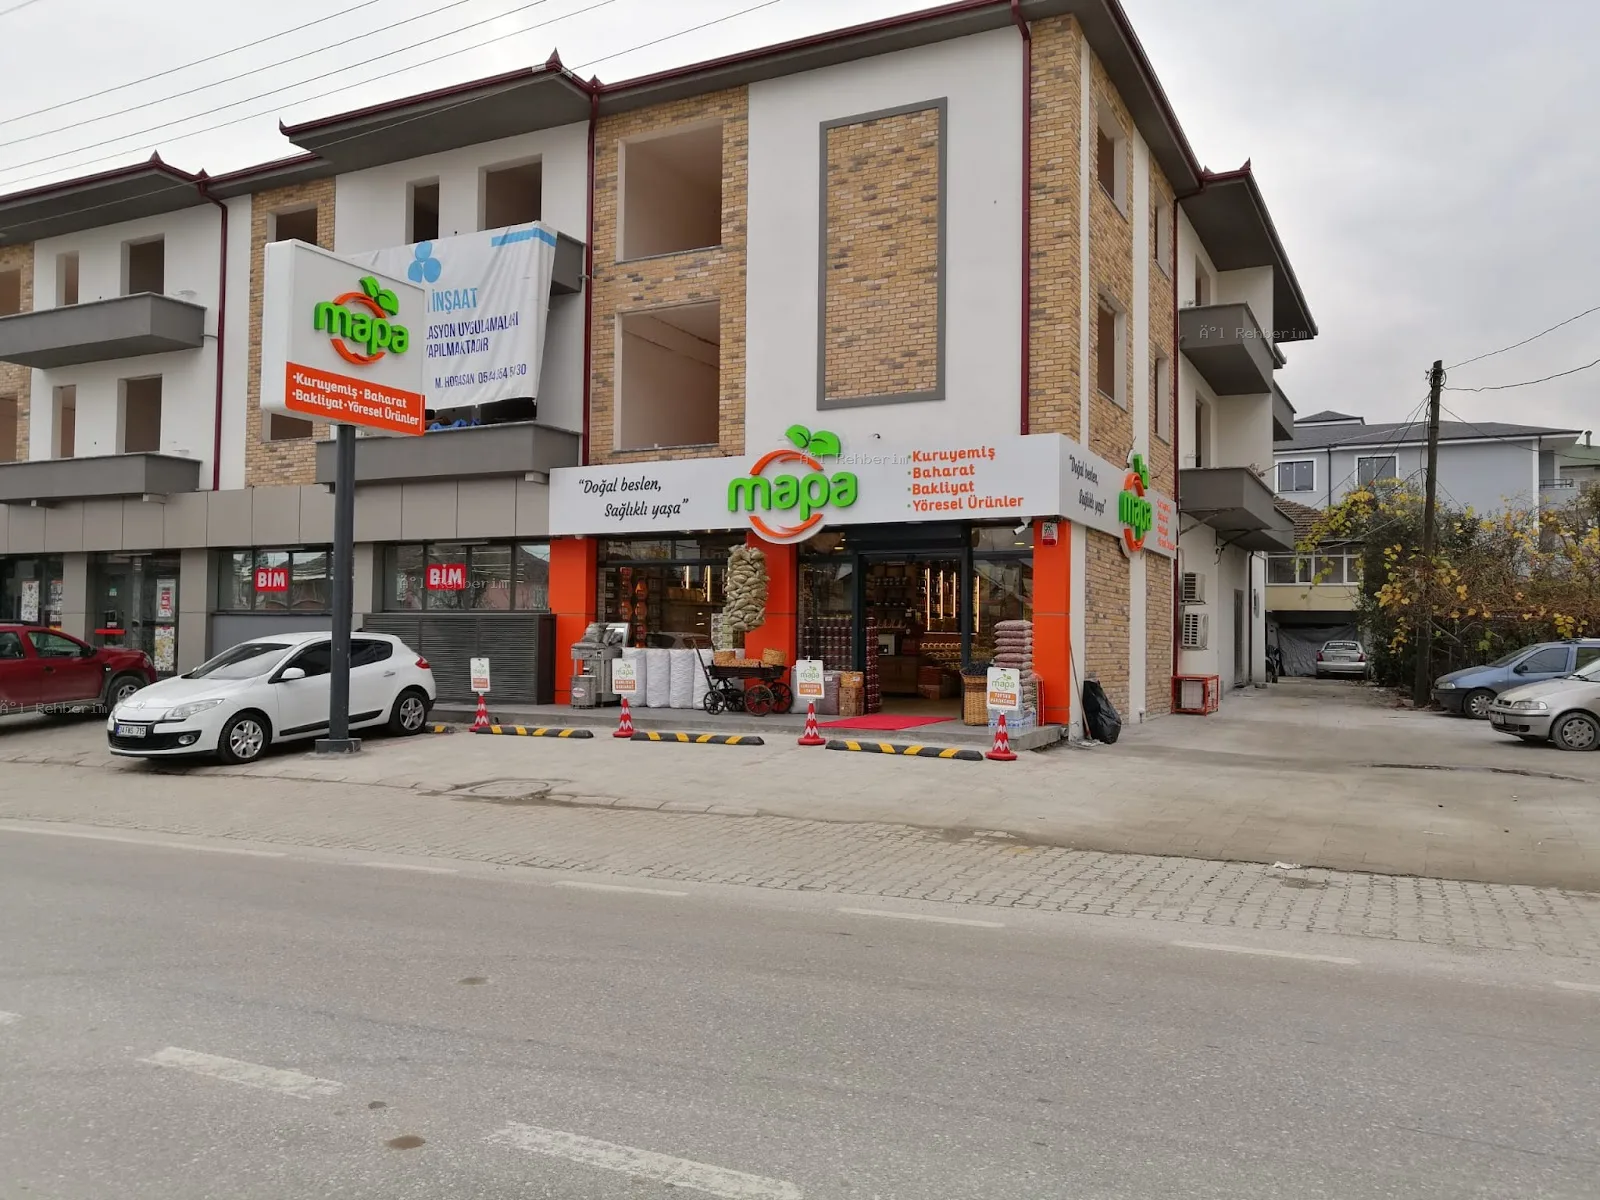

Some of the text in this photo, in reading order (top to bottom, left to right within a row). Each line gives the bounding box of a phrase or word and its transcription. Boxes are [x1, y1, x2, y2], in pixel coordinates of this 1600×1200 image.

[431, 287, 478, 314] İNŞAAT
[314, 301, 409, 356] mapa
[426, 322, 456, 340] ASYON
[444, 373, 475, 388] HORASAN
[296, 372, 407, 409] Kuruyemiş Baharat
[296, 389, 420, 426] Bakliyat Yöresel Ürünler
[912, 445, 996, 466] Kuruyemiş
[912, 464, 975, 479] Baharat
[620, 474, 662, 493] beslen,
[912, 480, 975, 496] Bakliyat
[727, 471, 859, 521] mapa
[912, 495, 1024, 512] Yöresel Ürünler
[604, 502, 648, 521] Sağlıklı
[1118, 490, 1152, 541] mapa
[616, 668, 634, 678] mapa
[800, 671, 820, 680] mapa
[992, 680, 1015, 690] mapa
